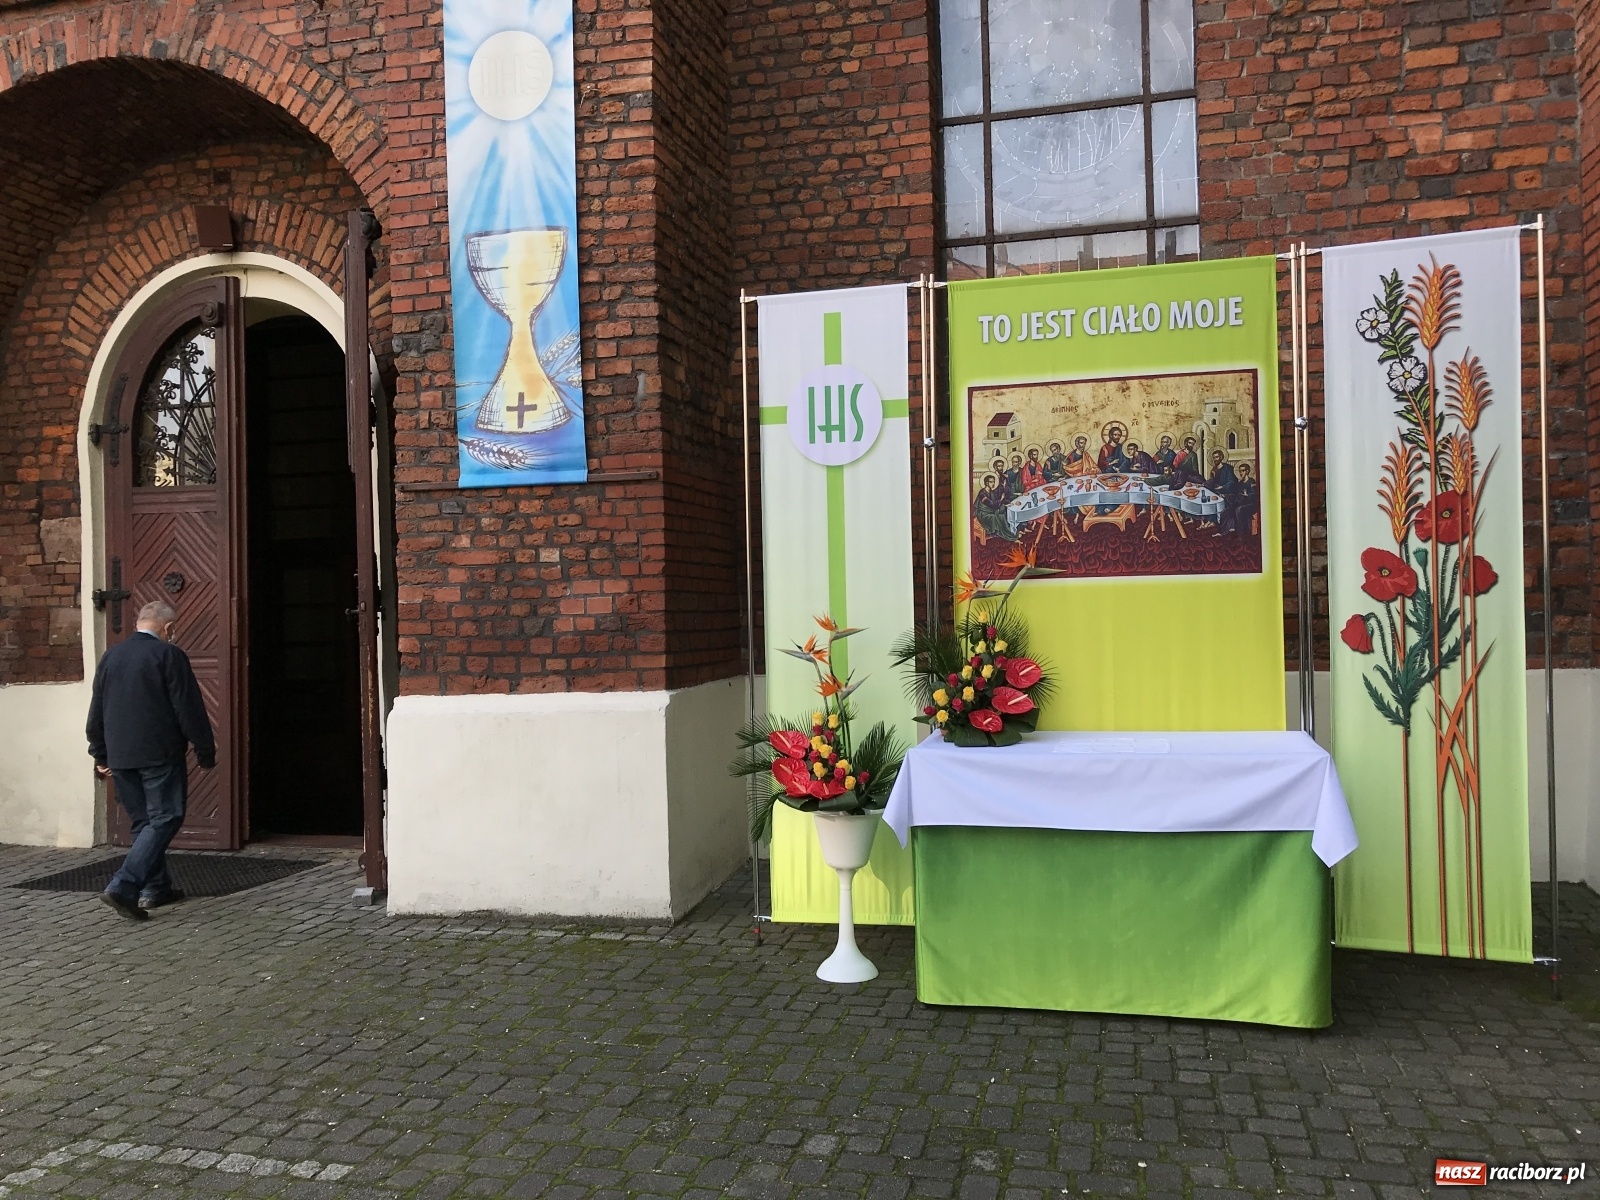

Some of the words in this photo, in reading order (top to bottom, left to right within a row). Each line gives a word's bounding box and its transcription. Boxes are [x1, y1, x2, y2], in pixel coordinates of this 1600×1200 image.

[978, 314, 1011, 343] TO
[1017, 309, 1076, 341] JEST
[1082, 303, 1161, 336] CIAŁO
[1169, 296, 1243, 330] MOJE
[808, 383, 864, 444] IHS
